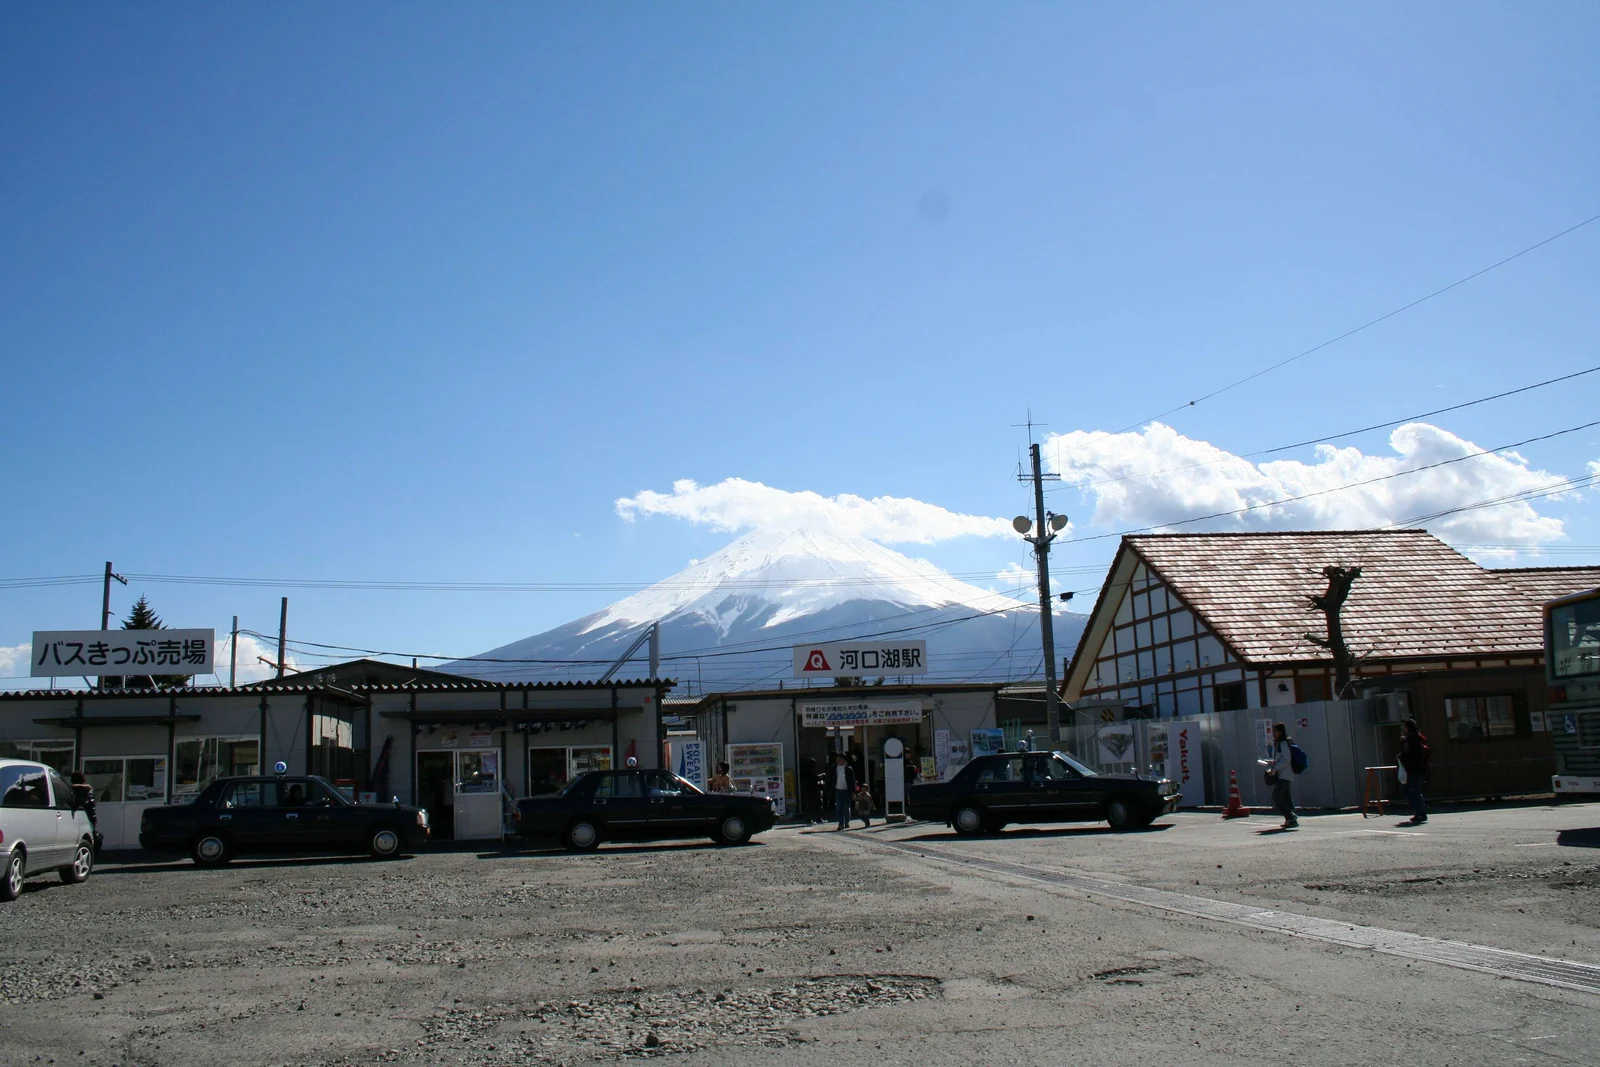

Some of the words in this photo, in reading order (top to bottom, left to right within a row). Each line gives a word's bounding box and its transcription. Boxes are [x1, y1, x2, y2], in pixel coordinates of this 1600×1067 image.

[38, 639, 206, 666] バスきっぷ売場
[839, 648, 922, 670] 河口湖駅
[685, 743, 694, 780] SWEAT
[692, 743, 701, 784] POCARI
[1179, 728, 1190, 785] Yakult
